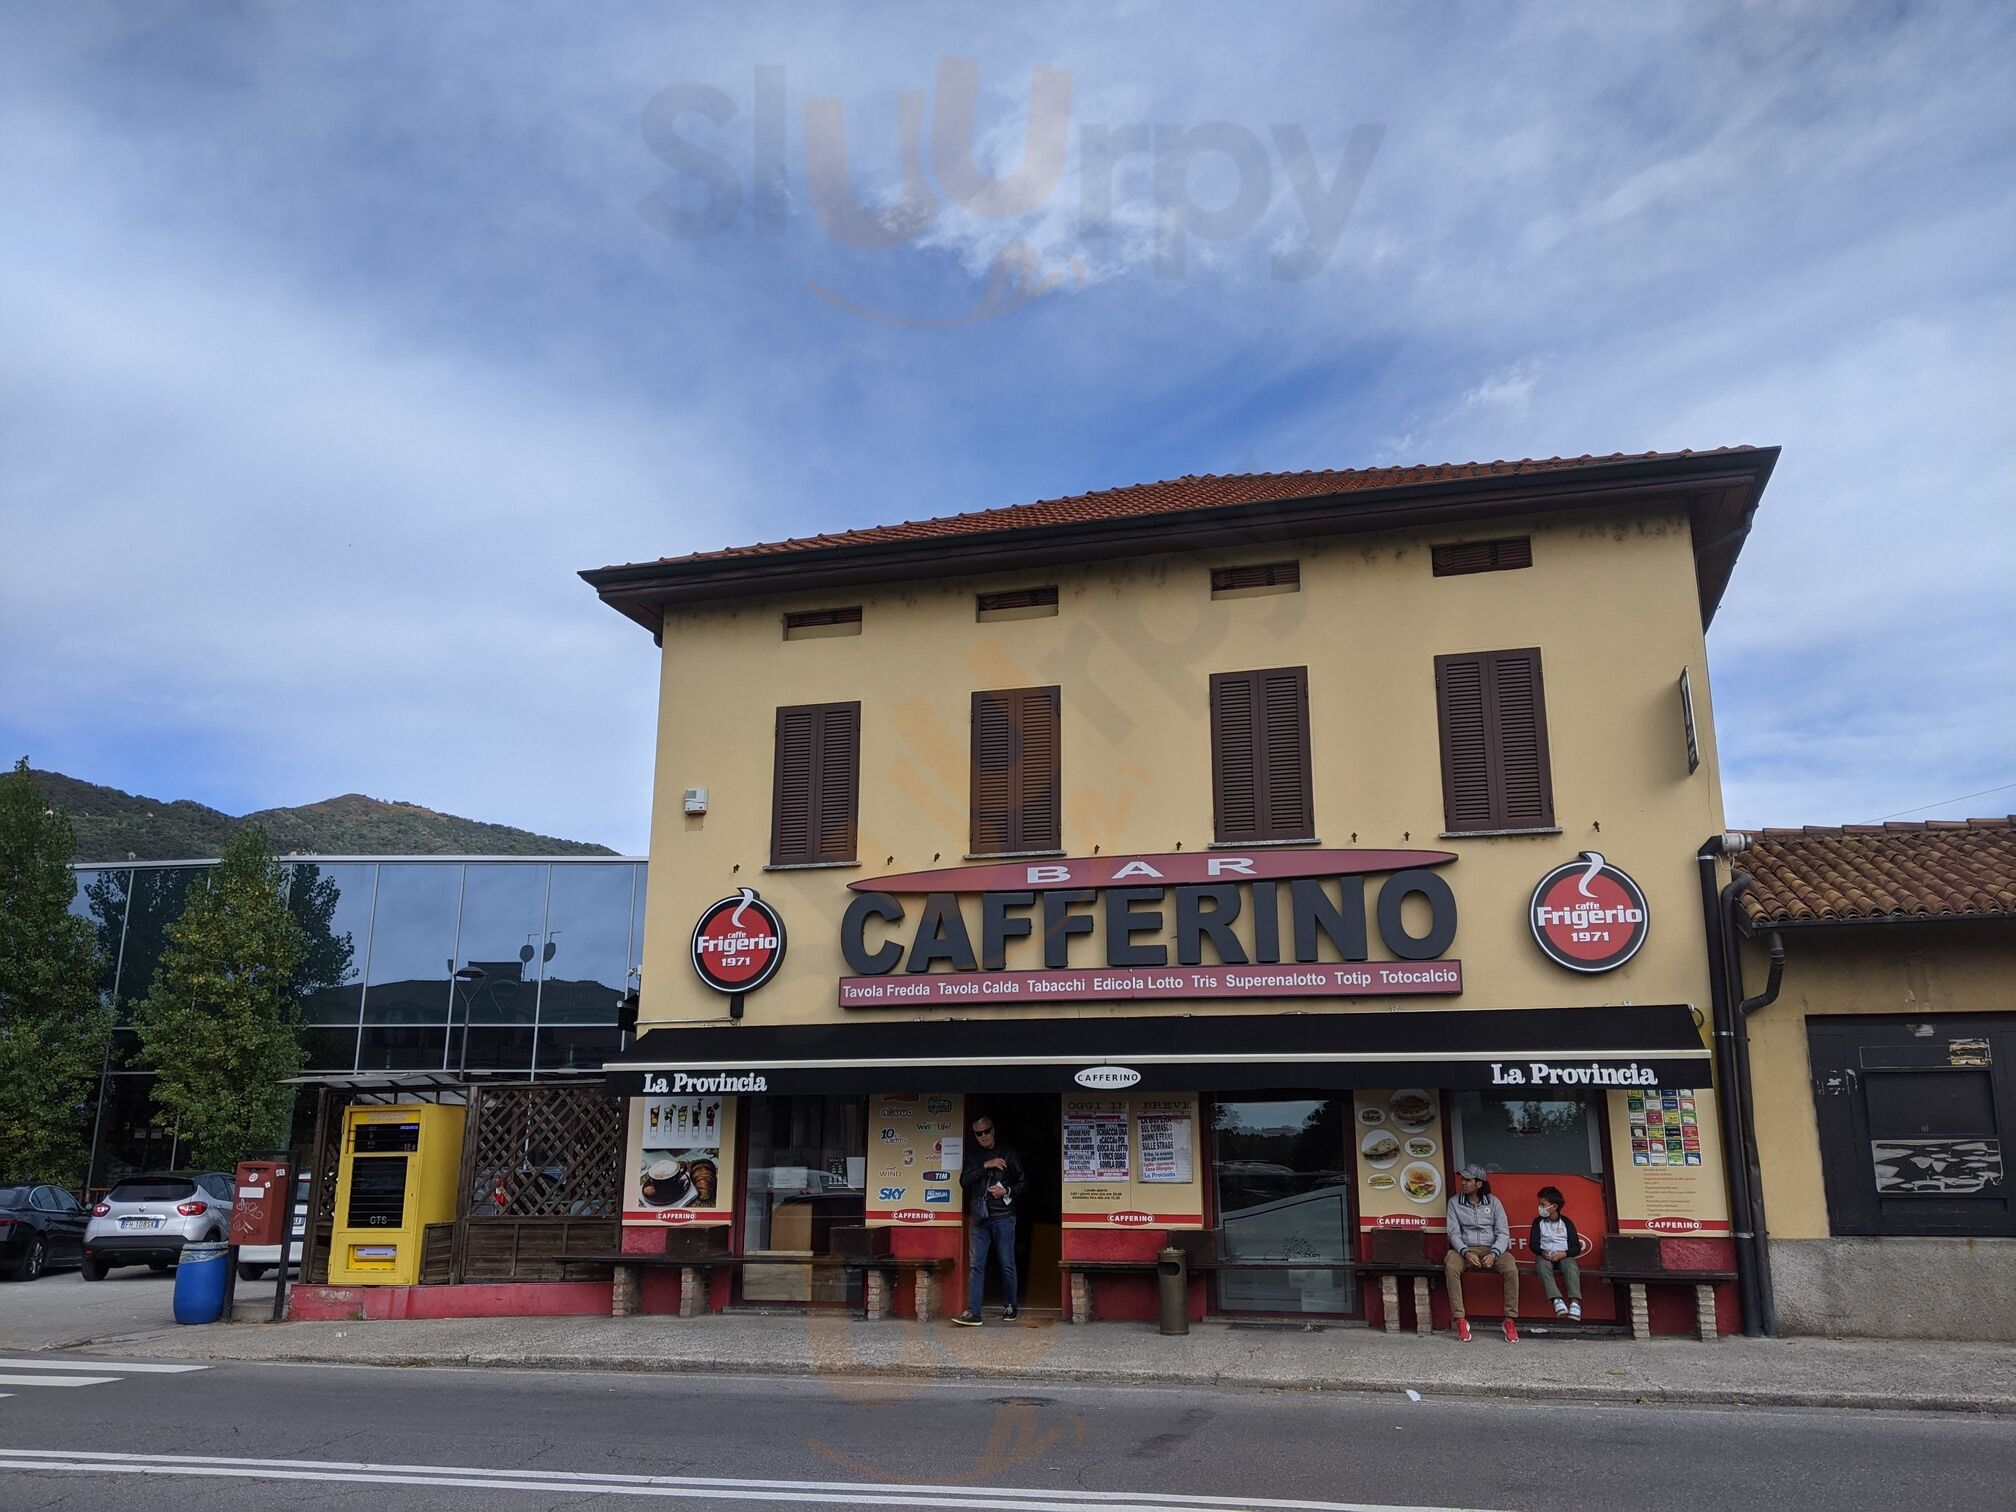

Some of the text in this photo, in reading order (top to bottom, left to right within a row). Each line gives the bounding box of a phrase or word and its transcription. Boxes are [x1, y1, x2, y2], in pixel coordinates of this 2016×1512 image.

[1027, 858, 1257, 884] BAR
[1576, 902, 1600, 910] caffe
[841, 869, 1458, 976] CAFFERINO
[1537, 905, 1643, 929] Frigerio
[728, 931, 746, 939] caffe
[1571, 931, 1610, 942] 1971
[697, 934, 777, 955] Frigerio
[721, 957, 750, 966] 1971
[844, 970, 1458, 998] Tavola Fredda Tavola Calda Tabacchi Edicola Lotto Tris Superenalotto Totip Totocalcio
[1078, 1074, 1138, 1082] CAFFERINO
[1491, 1063, 1659, 1085] La Provincia
[643, 1072, 767, 1093] La Provincia
[1068, 1102, 1102, 1110] OGGI
[1142, 1101, 1192, 1109] BREVE
[881, 1128, 895, 1139] 10
[1143, 1141, 1174, 1150] SULLE STRADE
[879, 1188, 906, 1200] SKY
[370, 1216, 387, 1224] GTS
[1647, 1221, 1700, 1229] CAFFERINO
